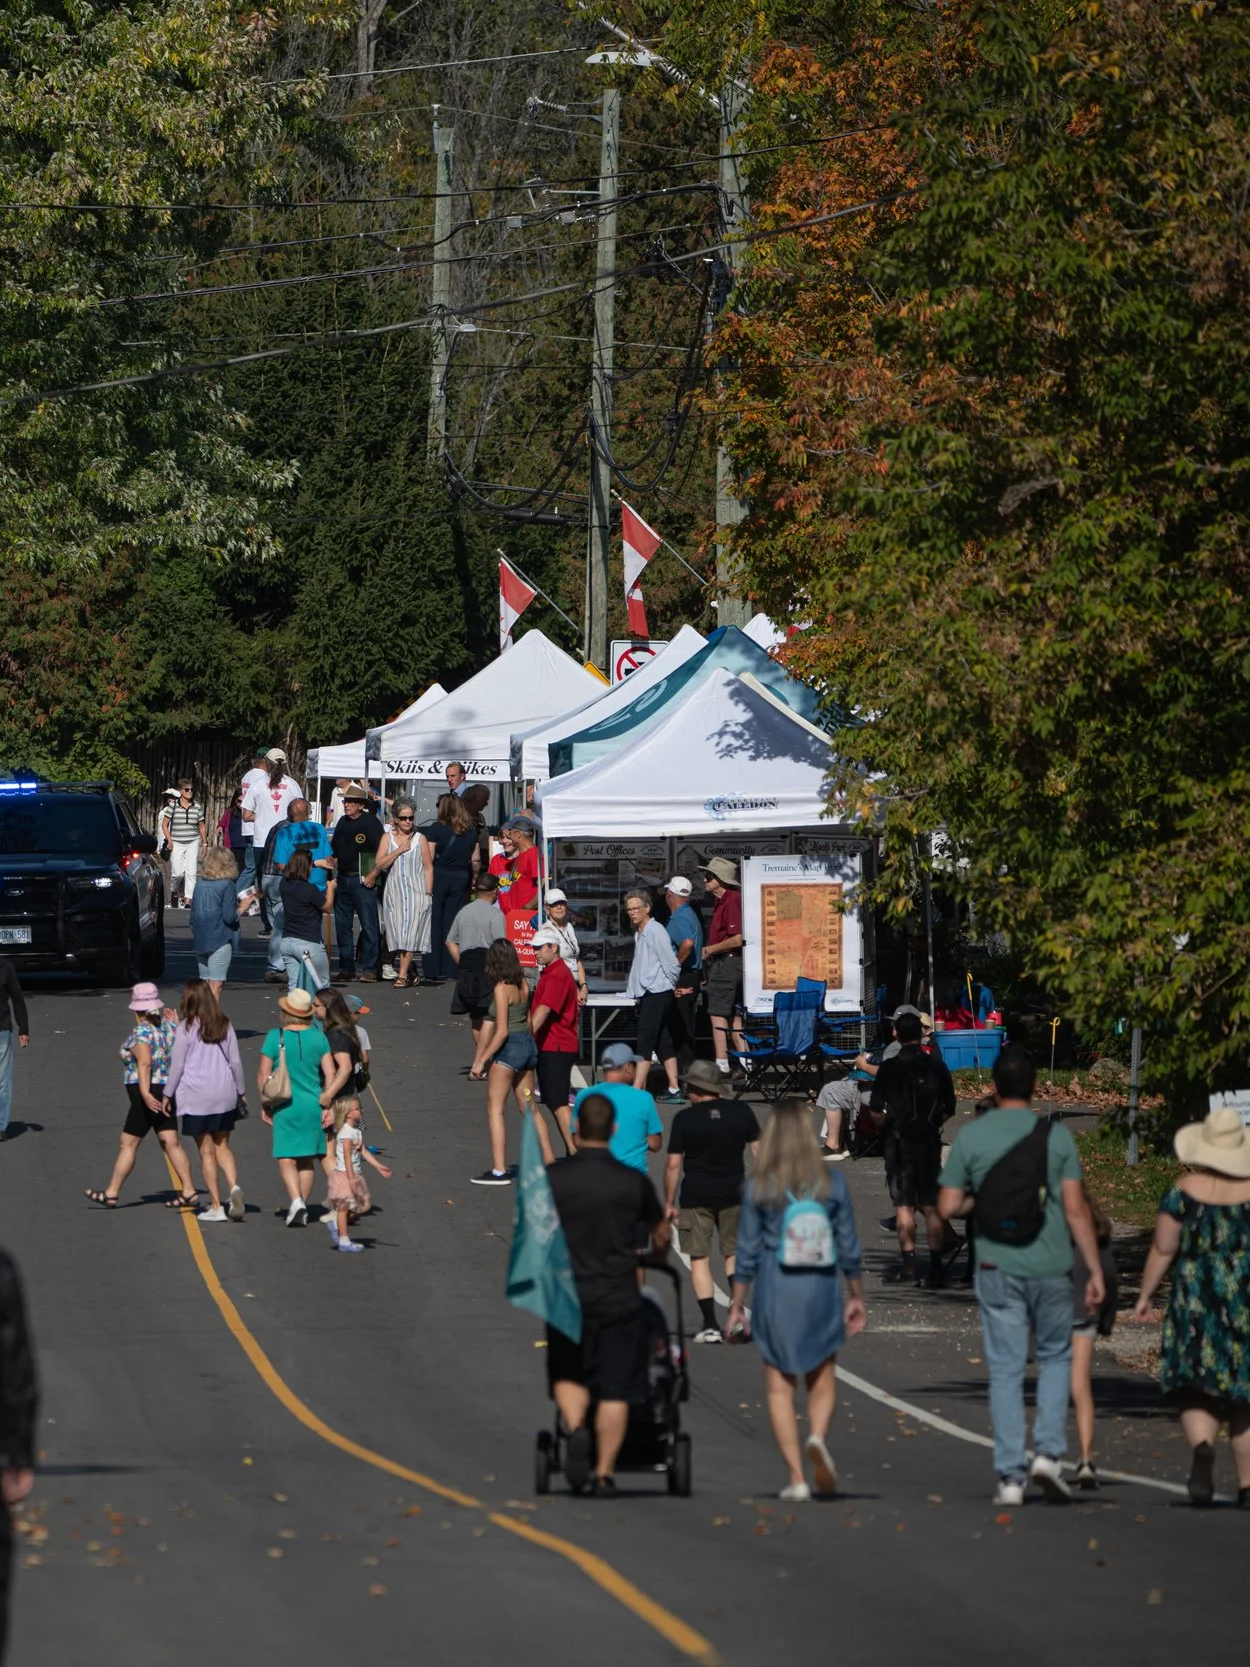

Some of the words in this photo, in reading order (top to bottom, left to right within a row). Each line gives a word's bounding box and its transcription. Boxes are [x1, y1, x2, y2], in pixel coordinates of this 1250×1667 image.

[385, 760, 425, 774] Skiis
[427, 760, 444, 775] &
[712, 800, 780, 812] CALEDON
[583, 845, 604, 856] Post
[606, 844, 636, 858] Offices
[704, 845, 756, 857] Community
[762, 863, 803, 873] Tremaine's
[803, 863, 822, 874] Map
[513, 920, 529, 931] SAY
